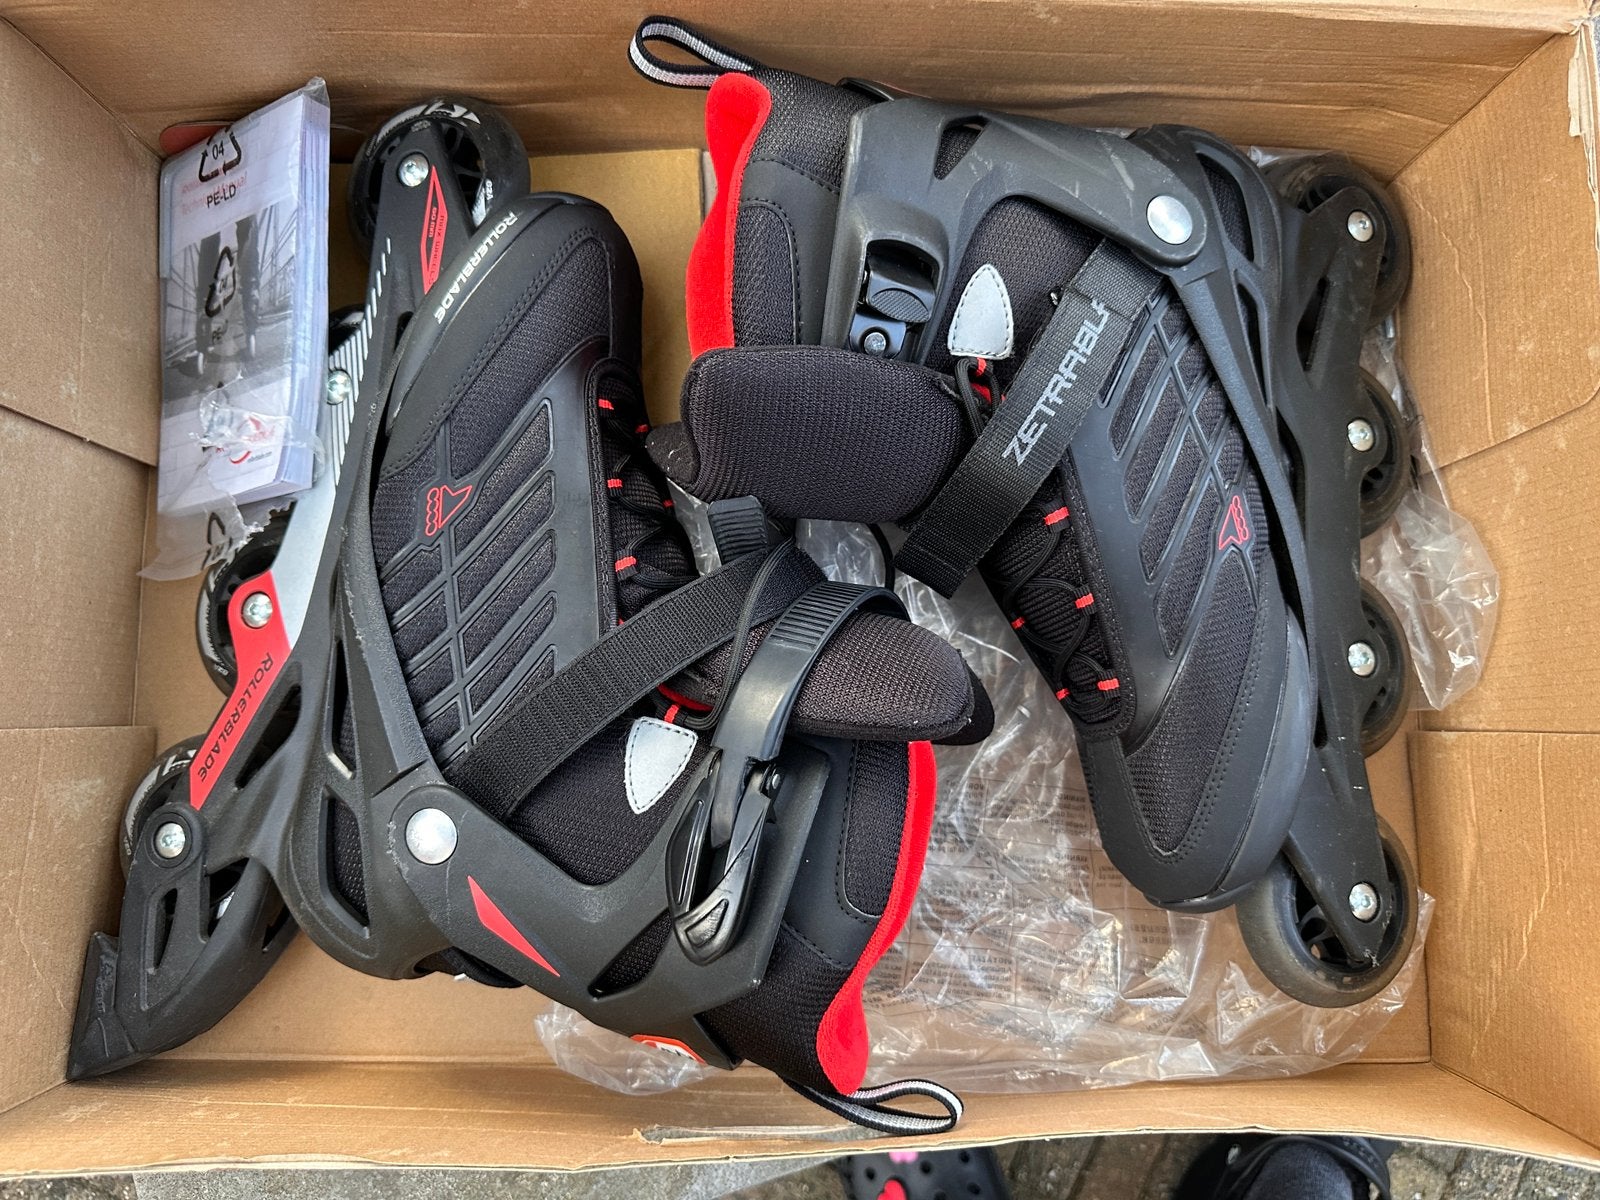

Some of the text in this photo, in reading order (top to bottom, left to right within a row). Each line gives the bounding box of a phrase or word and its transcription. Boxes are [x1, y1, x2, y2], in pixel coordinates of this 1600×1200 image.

[212, 140, 225, 160] 04
[206, 184, 237, 209] PE-LD
[433, 211, 520, 324] ROLLERBLADE
[197, 651, 275, 783] ROLLERBLADE
